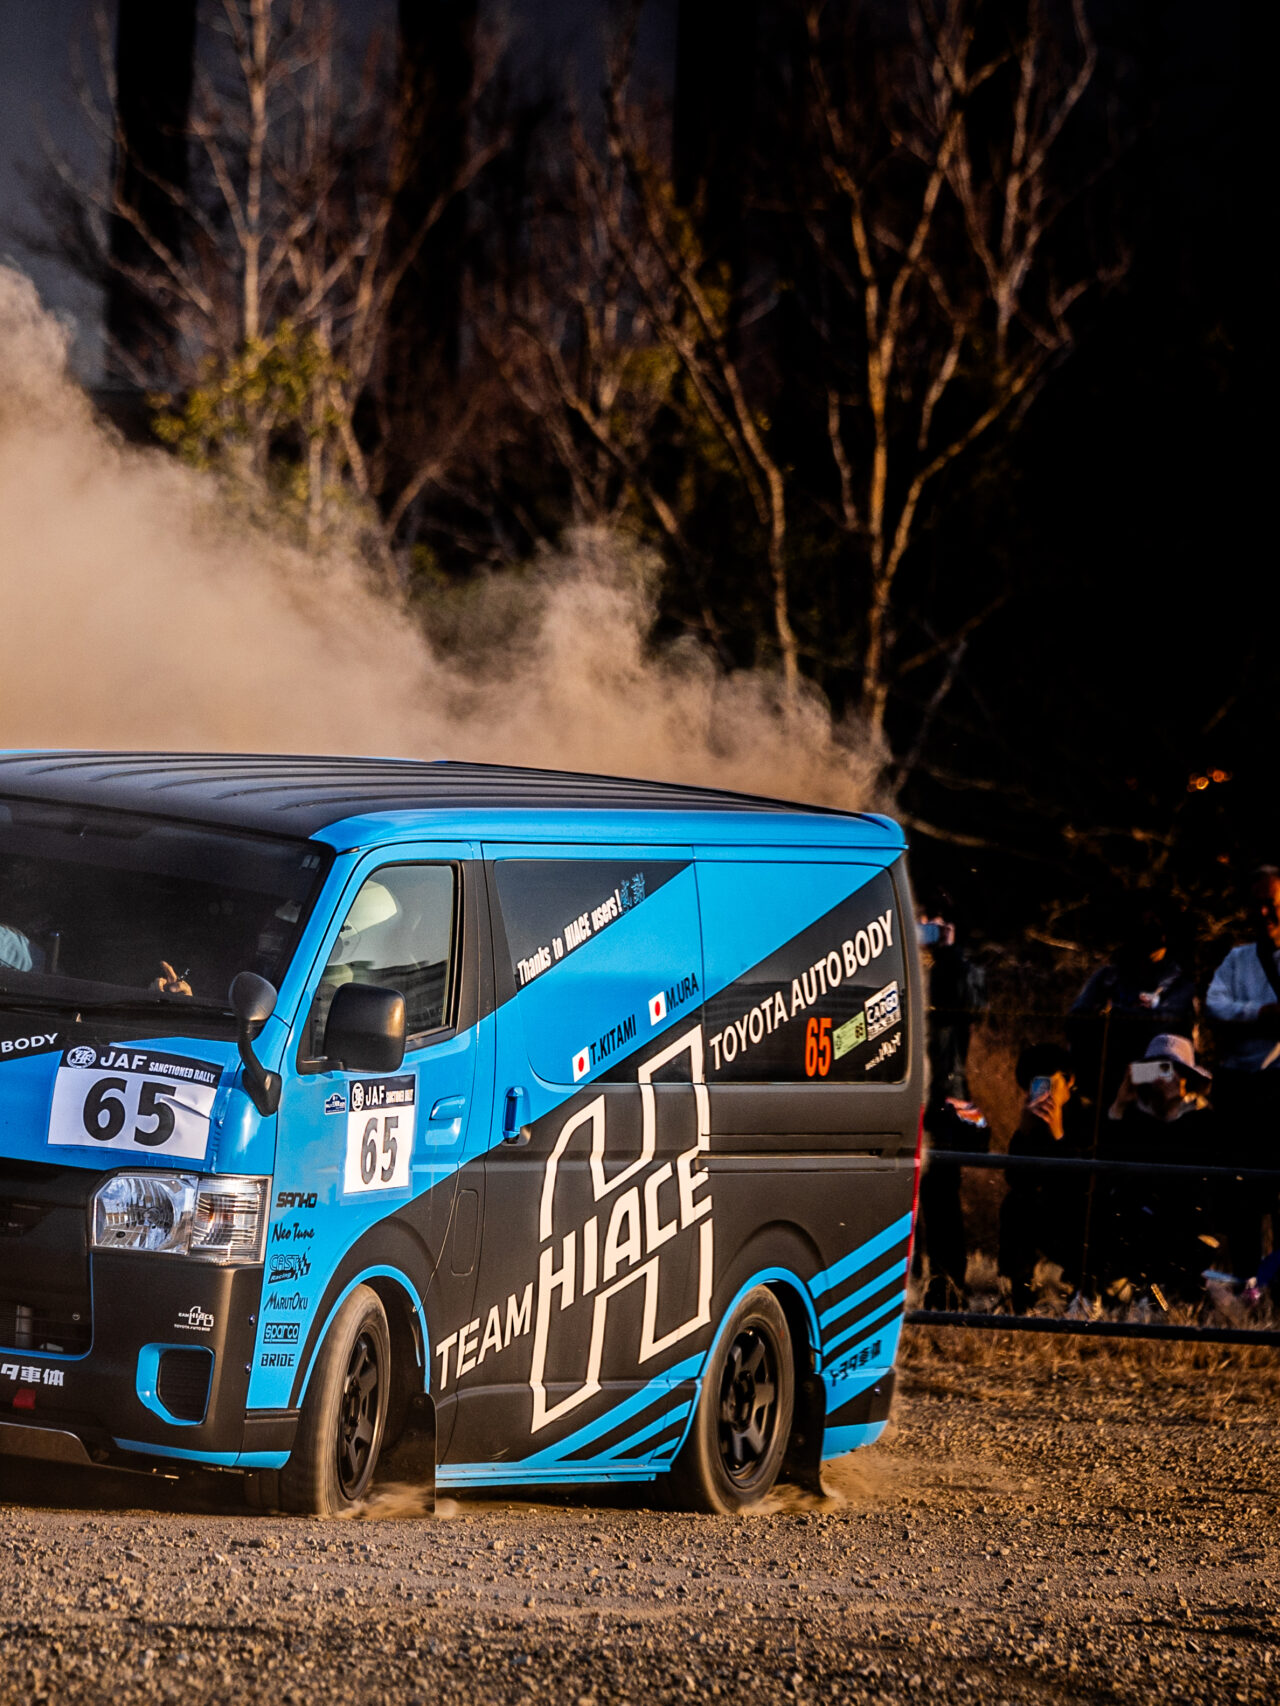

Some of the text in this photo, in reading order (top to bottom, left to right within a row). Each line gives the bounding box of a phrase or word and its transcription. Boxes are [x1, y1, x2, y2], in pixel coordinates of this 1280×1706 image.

[517, 889, 622, 985] Thanks to HIACE users!
[666, 972, 699, 1012] M.URA
[709, 991, 789, 1071] TOYOTA
[791, 951, 842, 1017] AUTO
[842, 909, 893, 978] BODY
[1, 1033, 59, 1054] BODY
[590, 1014, 637, 1065] T.KITAMI
[805, 1017, 832, 1077] 65
[100, 1052, 216, 1084] JAF SANCTIONED RALLY
[83, 1077, 177, 1147] 65
[365, 1085, 385, 1106] JAF
[361, 1115, 399, 1185] 65
[271, 1222, 315, 1243] Neo Tune
[435, 1145, 712, 1391] TEAM HIACE
[265, 1324, 299, 1342] sparco
[261, 1353, 295, 1367] BRIDE
